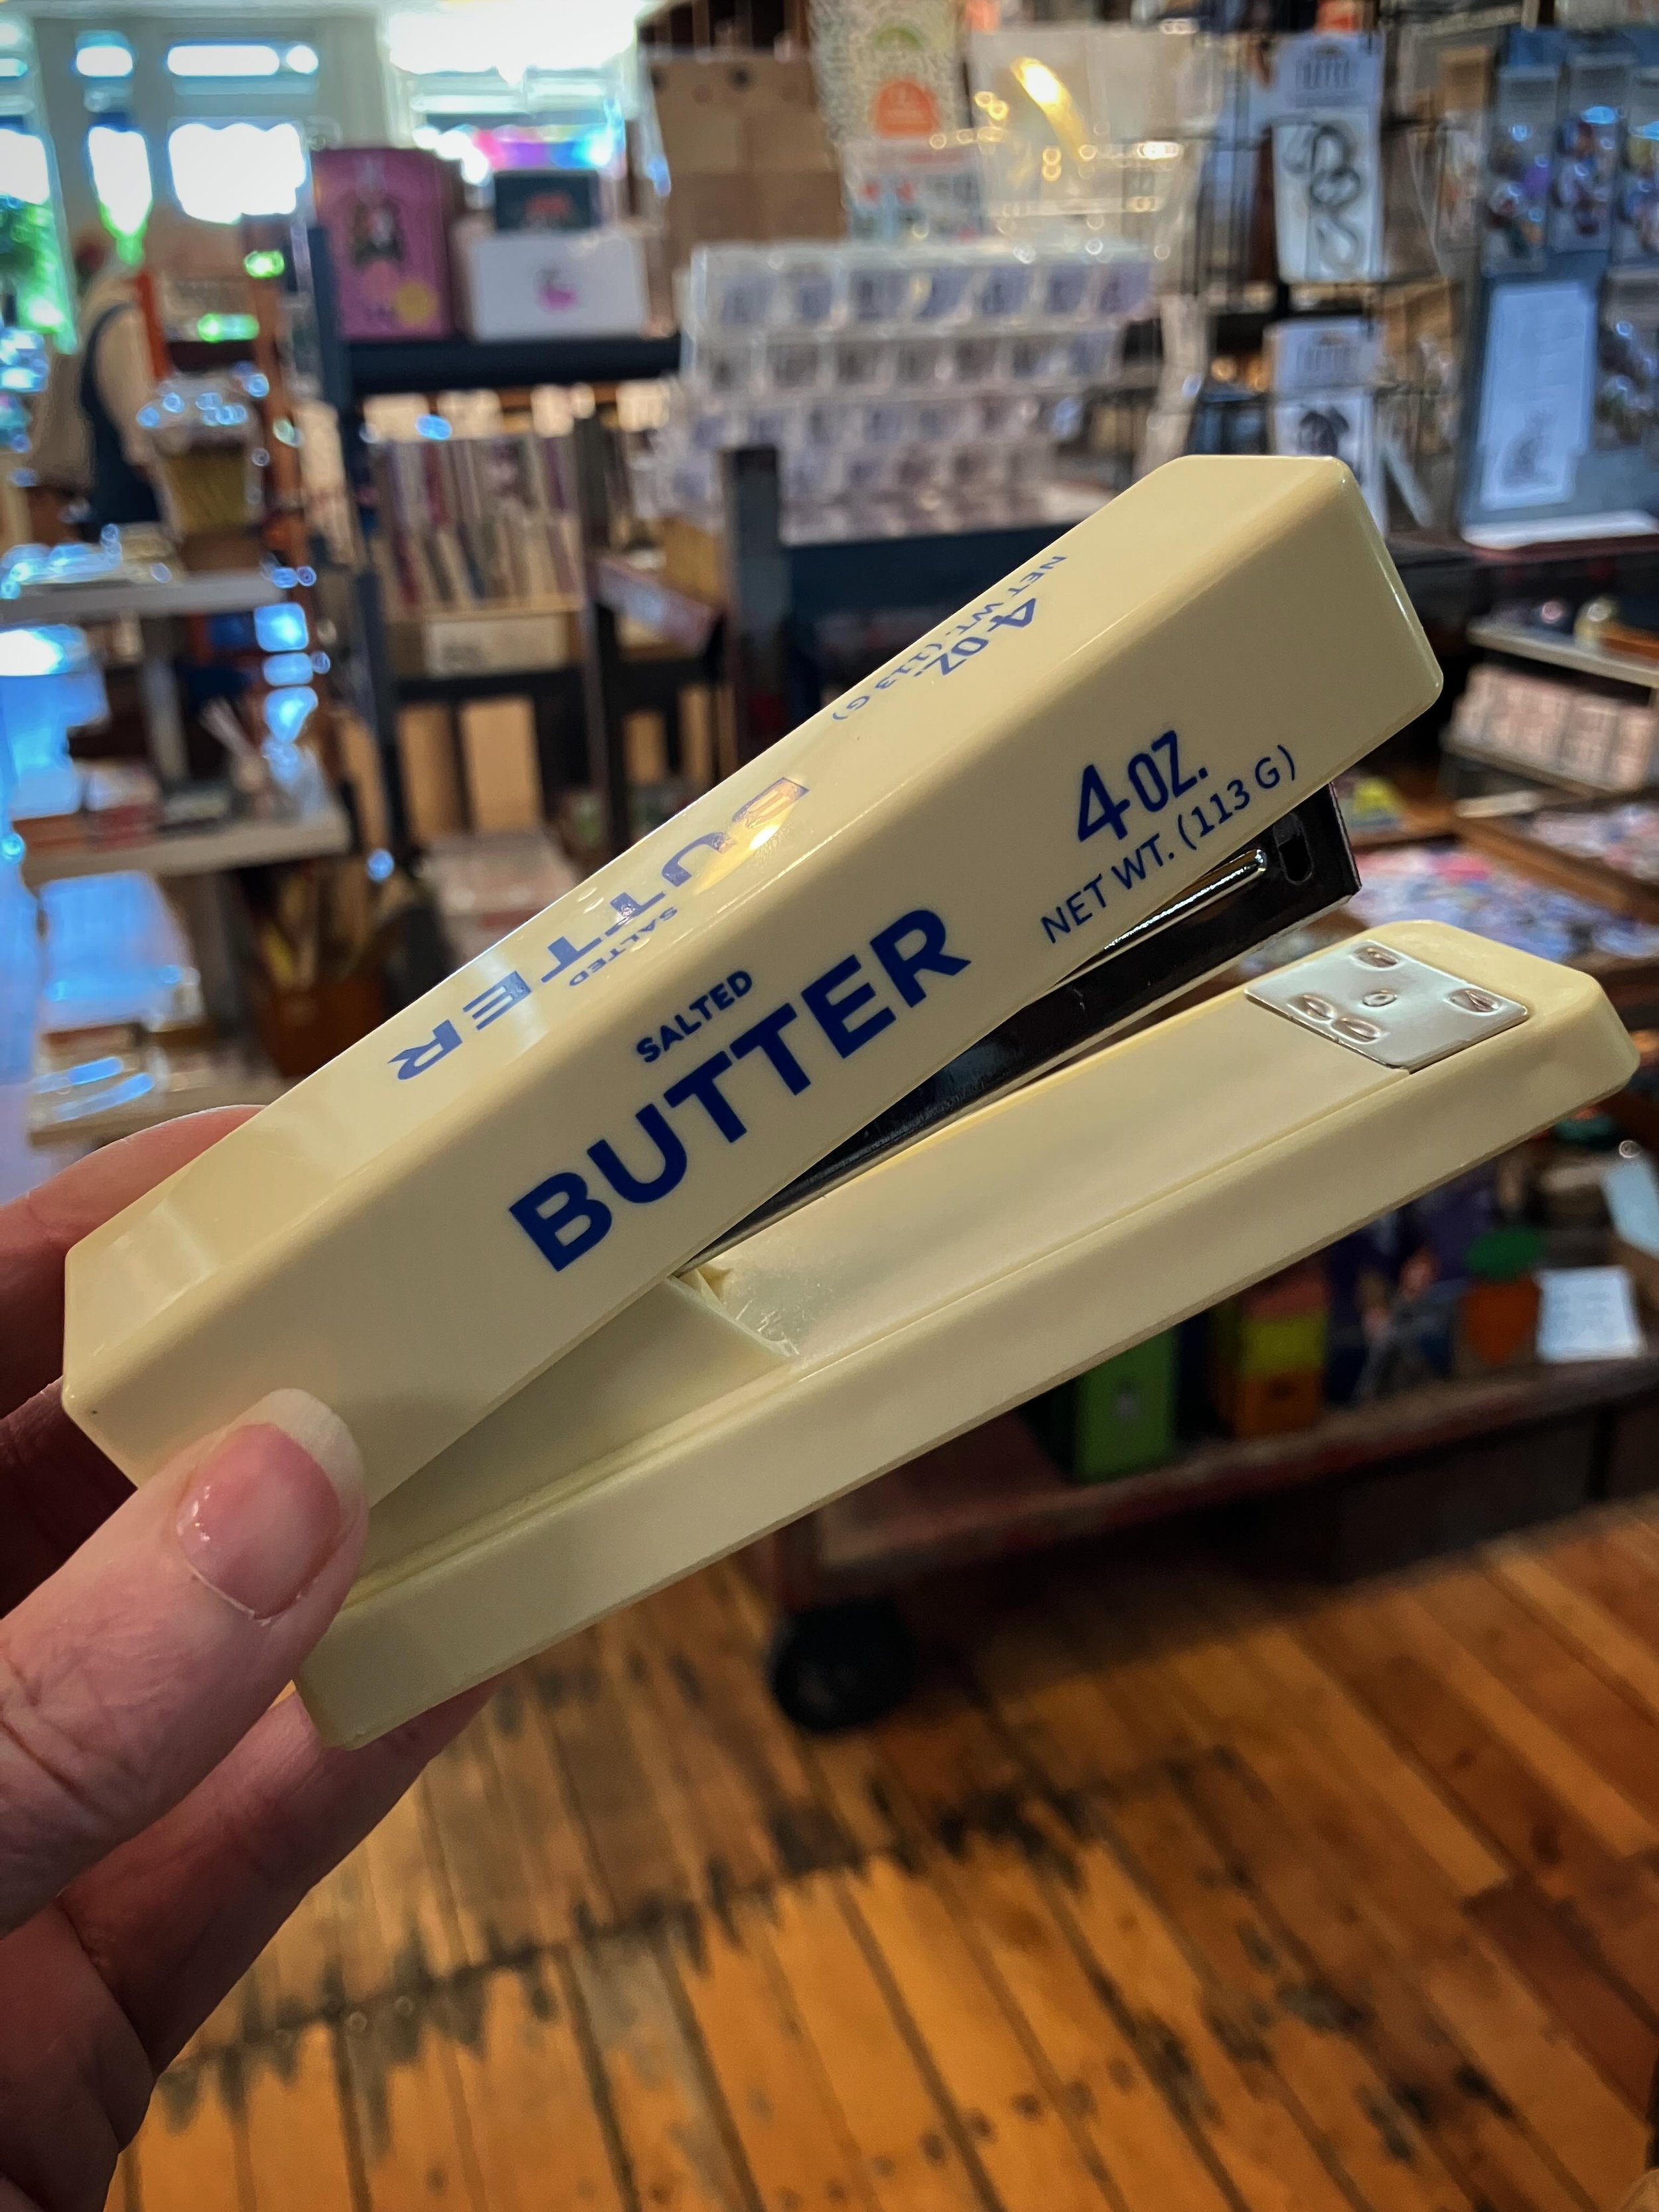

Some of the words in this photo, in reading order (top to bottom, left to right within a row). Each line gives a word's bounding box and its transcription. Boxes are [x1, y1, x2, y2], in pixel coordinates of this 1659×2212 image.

[987, 598, 1037, 632] 4
[1008, 555, 1068, 597] NET
[914, 636, 989, 676] OZ.
[945, 602, 1005, 636] WT.
[1078, 765, 1131, 842] 4
[1128, 730, 1208, 812] OZ.
[1041, 873, 1106, 944] NET
[1112, 833, 1175, 890] WT.
[1178, 779, 1251, 851] (113
[1255, 745, 1295, 789] G)
[569, 907, 678, 987] SALTED
[636, 970, 753, 1063] SALTED
[508, 909, 972, 1272] BUTTER
